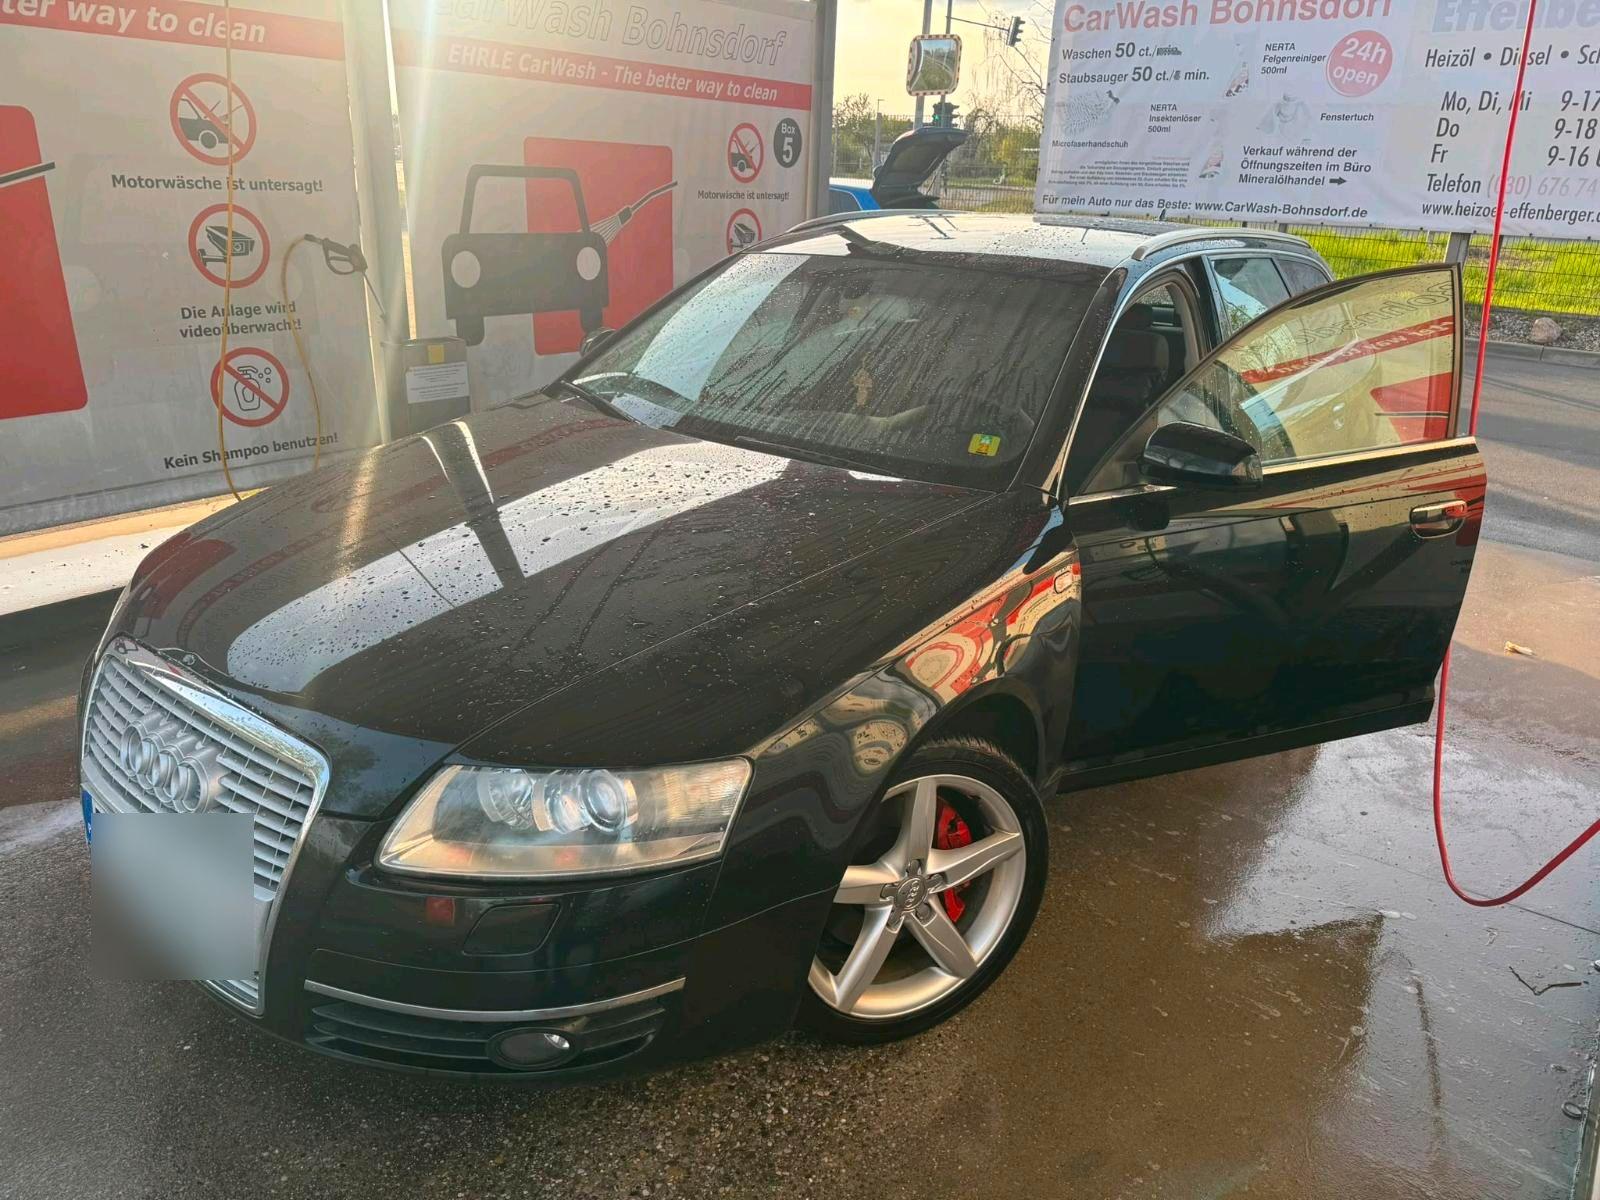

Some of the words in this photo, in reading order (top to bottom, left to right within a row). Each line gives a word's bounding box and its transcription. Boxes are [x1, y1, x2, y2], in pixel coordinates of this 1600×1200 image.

[67, 0, 137, 33] way
[147, 6, 178, 32] to
[188, 12, 266, 43] clean
[1064, 0, 1198, 32] CarWash
[622, 5, 786, 66] Bohnsdorf
[1062, 48, 1111, 60] Waschen
[1114, 42, 1136, 58] 50
[1264, 43, 1296, 51] NERTA
[1341, 38, 1388, 64] 24h
[1425, 47, 1476, 67] Heizöl
[1262, 54, 1327, 64] Felgenreiniger
[447, 43, 513, 70] EHRLE
[518, 53, 596, 80] CarWash
[613, 65, 641, 86] The
[646, 69, 692, 91] better
[695, 80, 723, 99] way
[727, 80, 740, 97] to
[743, 82, 777, 101] clean
[1059, 71, 1129, 86] Staubsauger
[1131, 66, 1153, 82] 50
[1184, 69, 1210, 81] min.
[1260, 66, 1288, 75] 500ml
[1332, 66, 1379, 87] open
[1150, 104, 1178, 112] NERTA
[1441, 90, 1471, 115] Mo,
[1478, 90, 1502, 115] Di,
[1149, 114, 1202, 123] Insektenlöser
[1319, 113, 1375, 122] Fenstertuch
[781, 122, 796, 134] Box
[1147, 125, 1171, 133] 500ml
[1436, 117, 1460, 138] Do
[1554, 118, 1598, 140] 9-18
[782, 137, 793, 163] 5
[1243, 145, 1284, 156] Verkauf
[1285, 147, 1334, 157] während
[1337, 147, 1357, 157] der
[1431, 143, 1449, 163] Fr
[1547, 145, 1590, 167] 9-16
[1240, 159, 1323, 172] Öffnungszeiten
[1325, 161, 1340, 172] im
[1343, 162, 1372, 173] Büro
[111, 174, 223, 190] Motorwäsche
[226, 176, 246, 190] ist
[249, 178, 323, 195] untersagt!
[1238, 173, 1325, 186] Mineralölhandel
[1427, 173, 1481, 193] Telefon
[746, 190, 756, 200] ist
[1042, 194, 1060, 205] Für
[1061, 195, 1086, 206] mein
[1087, 196, 1112, 207] Auto
[1114, 199, 1133, 209] nur
[1135, 198, 1155, 209] das
[1157, 199, 1192, 210] Beste:
[1195, 201, 1368, 218] www.CarWash-Bohnsdorf.de
[180, 306, 207, 320] Die
[164, 454, 198, 469] Kein
[272, 432, 339, 453] benutzen!
